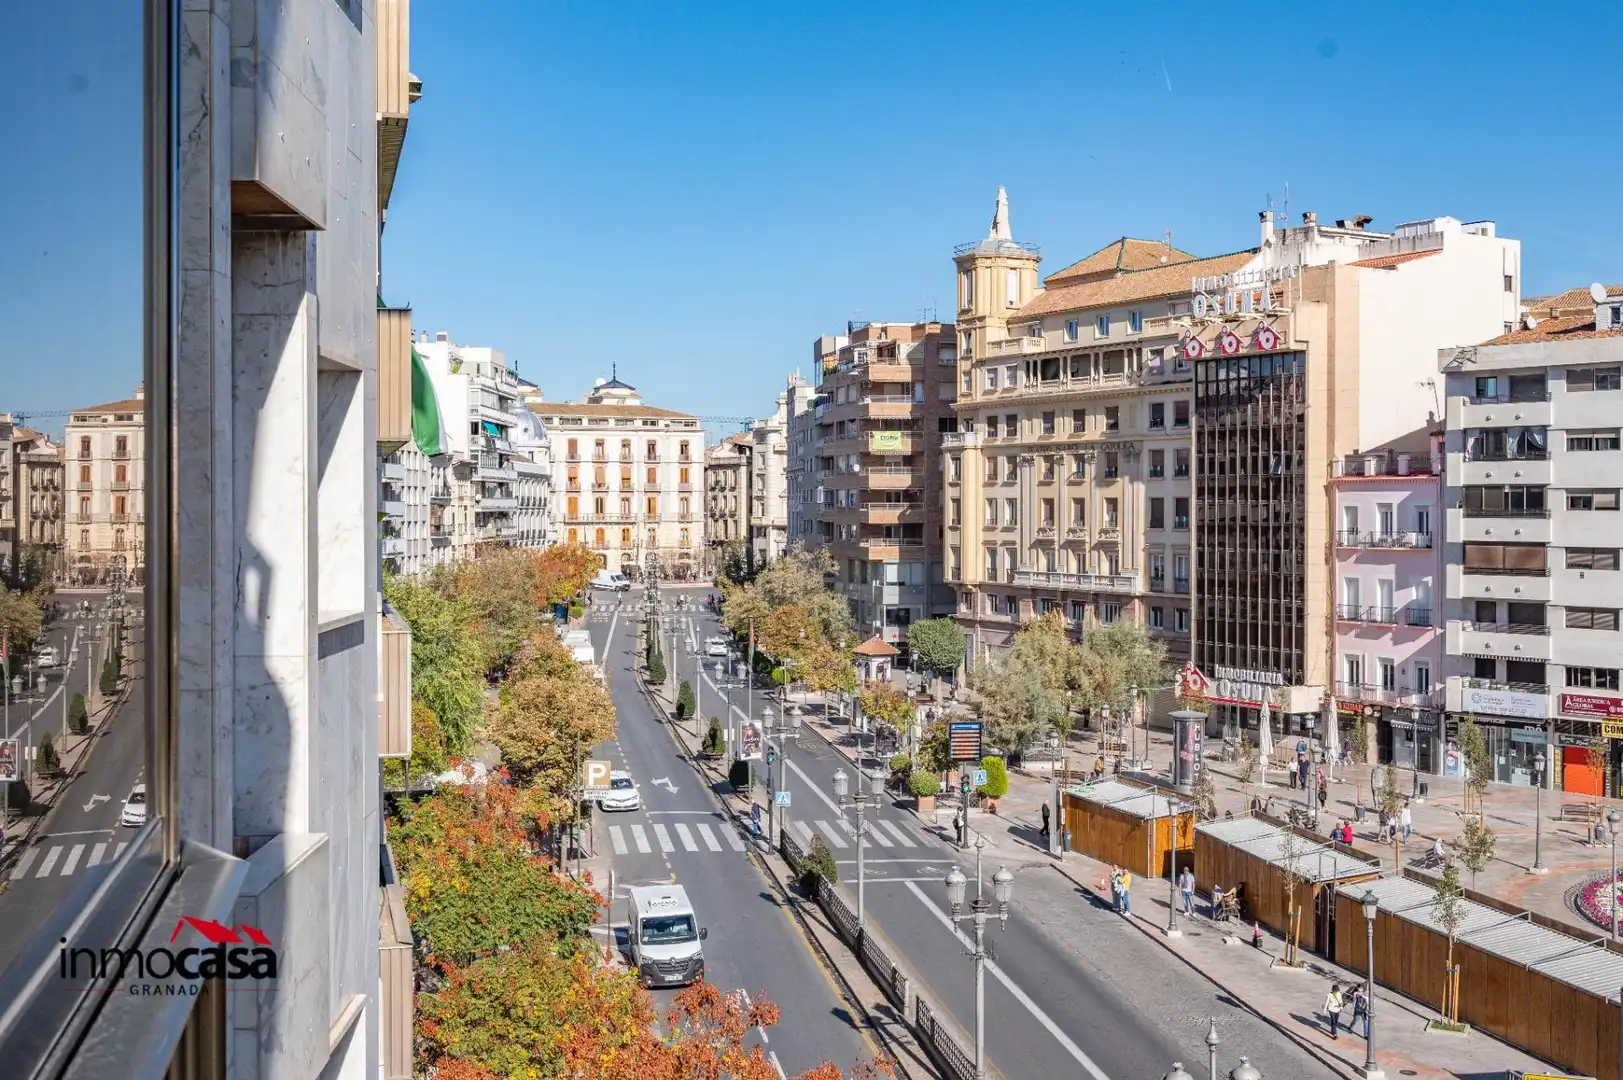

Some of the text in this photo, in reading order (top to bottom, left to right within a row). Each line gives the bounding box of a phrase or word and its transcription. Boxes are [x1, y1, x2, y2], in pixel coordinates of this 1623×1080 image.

[1192, 285, 1271, 319] OSUNA
[1215, 663, 1283, 686] INMOBILIARIA
[1219, 678, 1272, 703] OSUNA
[1193, 723, 1201, 781] HUBLOT
[588, 763, 606, 785] P
